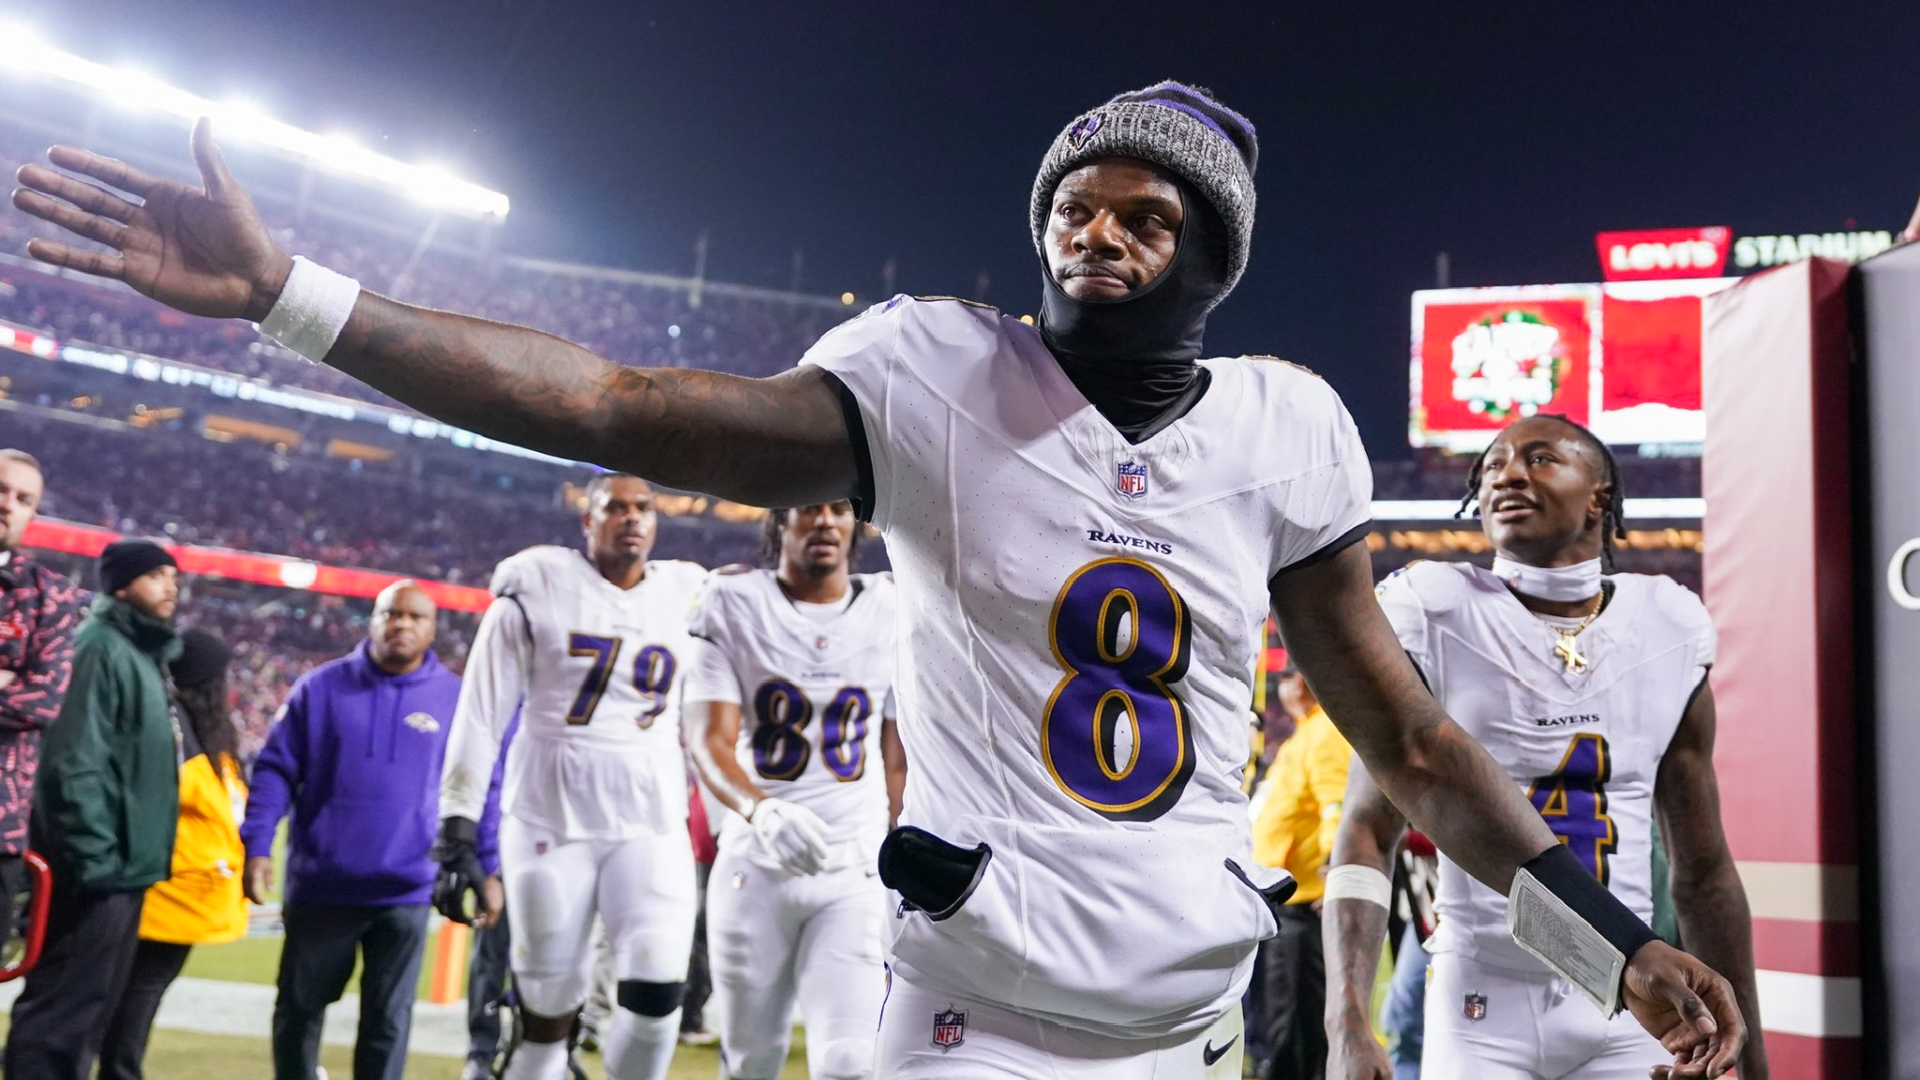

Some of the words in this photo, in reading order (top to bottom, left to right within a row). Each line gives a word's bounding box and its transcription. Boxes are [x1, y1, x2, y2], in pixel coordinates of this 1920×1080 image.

[1734, 230, 1892, 268] STADIUM
[1119, 474, 1144, 493] NFL
[1086, 529, 1173, 555] RAVENS
[566, 630, 677, 729] 79
[1041, 556, 1196, 822] 8
[752, 677, 874, 783] 80
[1535, 713, 1601, 726] RAVENS
[1527, 732, 1619, 889] 4
[1464, 1002, 1485, 1018] NFL
[936, 1025, 961, 1043] NFL
